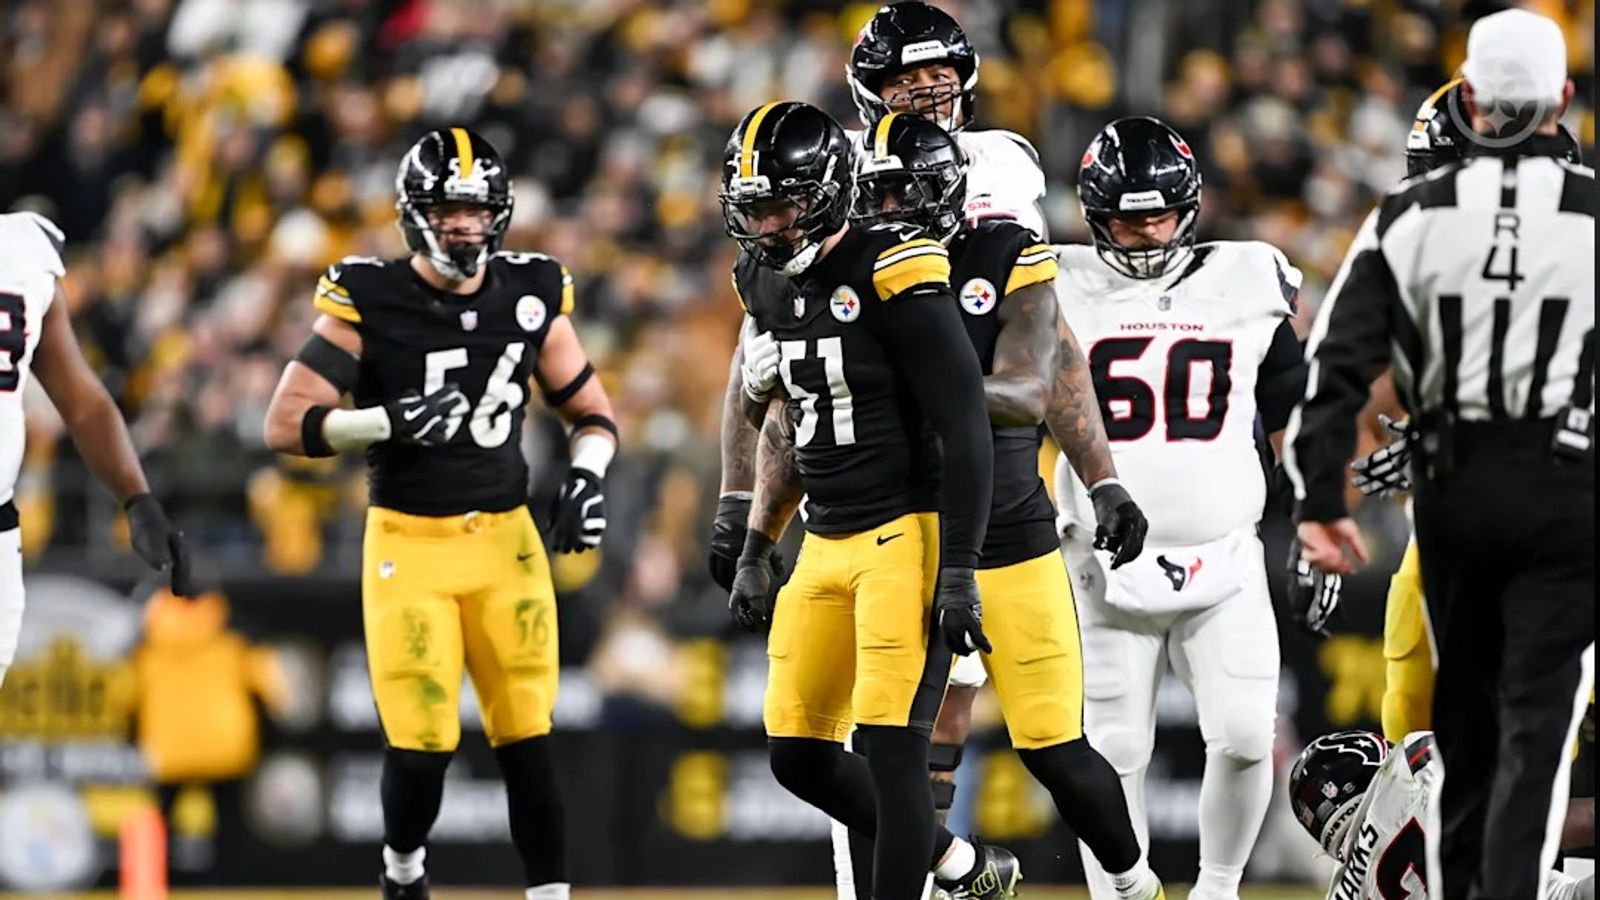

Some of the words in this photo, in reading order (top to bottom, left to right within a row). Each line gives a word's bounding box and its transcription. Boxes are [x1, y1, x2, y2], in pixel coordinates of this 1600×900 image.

[1494, 213, 1521, 239] R
[1482, 245, 1525, 291] 4
[1119, 321, 1205, 332] HOUSTON
[424, 341, 526, 449] 56
[778, 336, 857, 448] 51
[1088, 335, 1234, 443] 60
